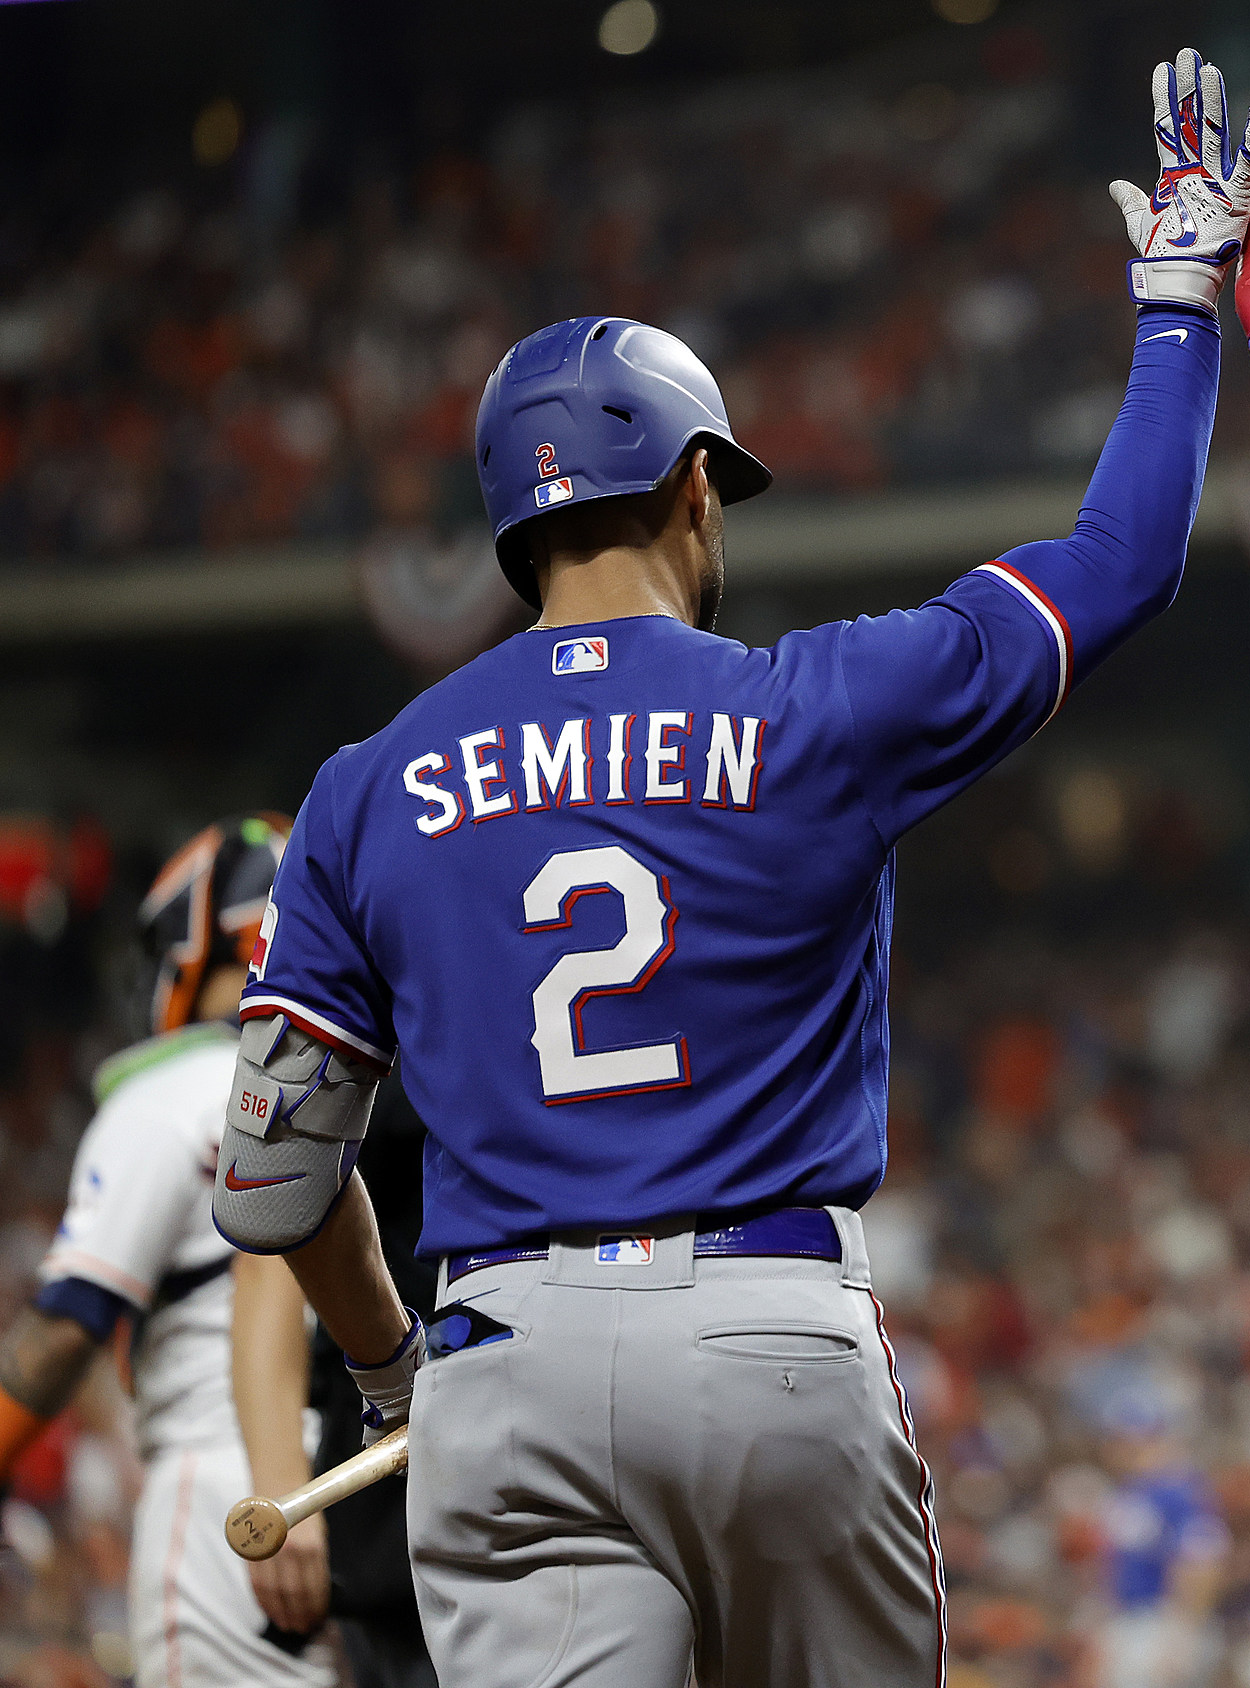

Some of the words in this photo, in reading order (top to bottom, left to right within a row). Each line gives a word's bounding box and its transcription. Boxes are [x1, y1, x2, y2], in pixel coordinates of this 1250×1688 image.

[535, 443, 559, 479] 2
[402, 710, 768, 838] SEMIEN
[519, 842, 692, 1106] 2
[240, 1090, 268, 1119] 510
[244, 1519, 260, 1536] 2
